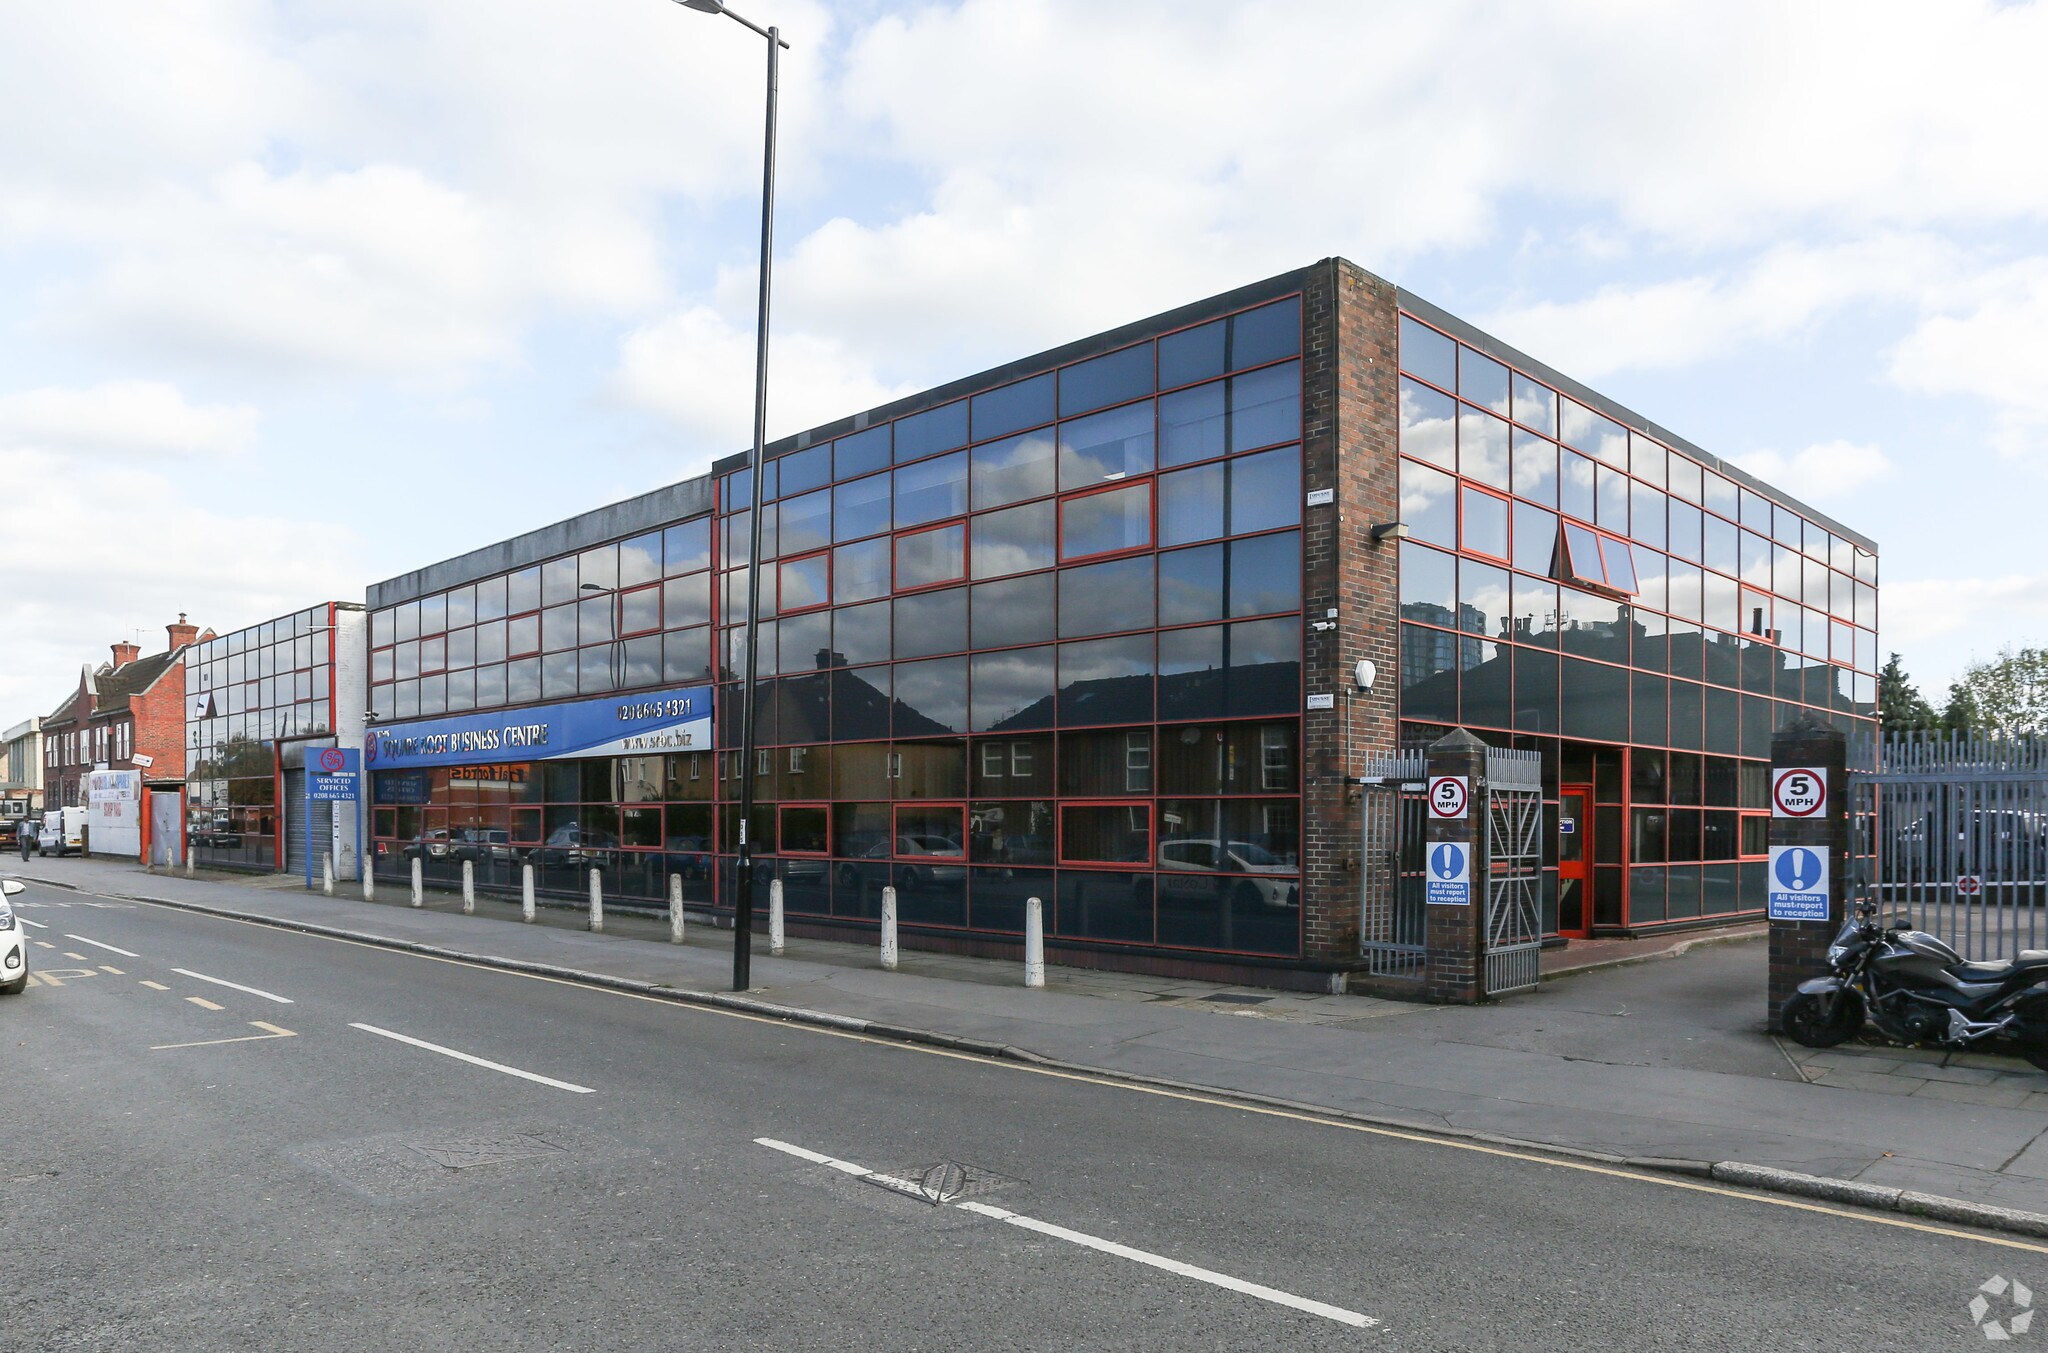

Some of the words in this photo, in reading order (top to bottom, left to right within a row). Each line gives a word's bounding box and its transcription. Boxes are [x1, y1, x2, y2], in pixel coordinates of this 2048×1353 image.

[383, 737, 418, 760] SQUARE
[420, 734, 448, 754] ROOT
[451, 728, 500, 752] BUSINESS
[503, 724, 548, 748] CENTRE
[620, 728, 692, 750] www.srbc.biz
[1441, 783, 1455, 799] 5
[1790, 776, 1809, 796] 5
[1790, 894, 1821, 902] visitors
[1796, 902, 1823, 910] report
[1784, 910, 1824, 918] reception
